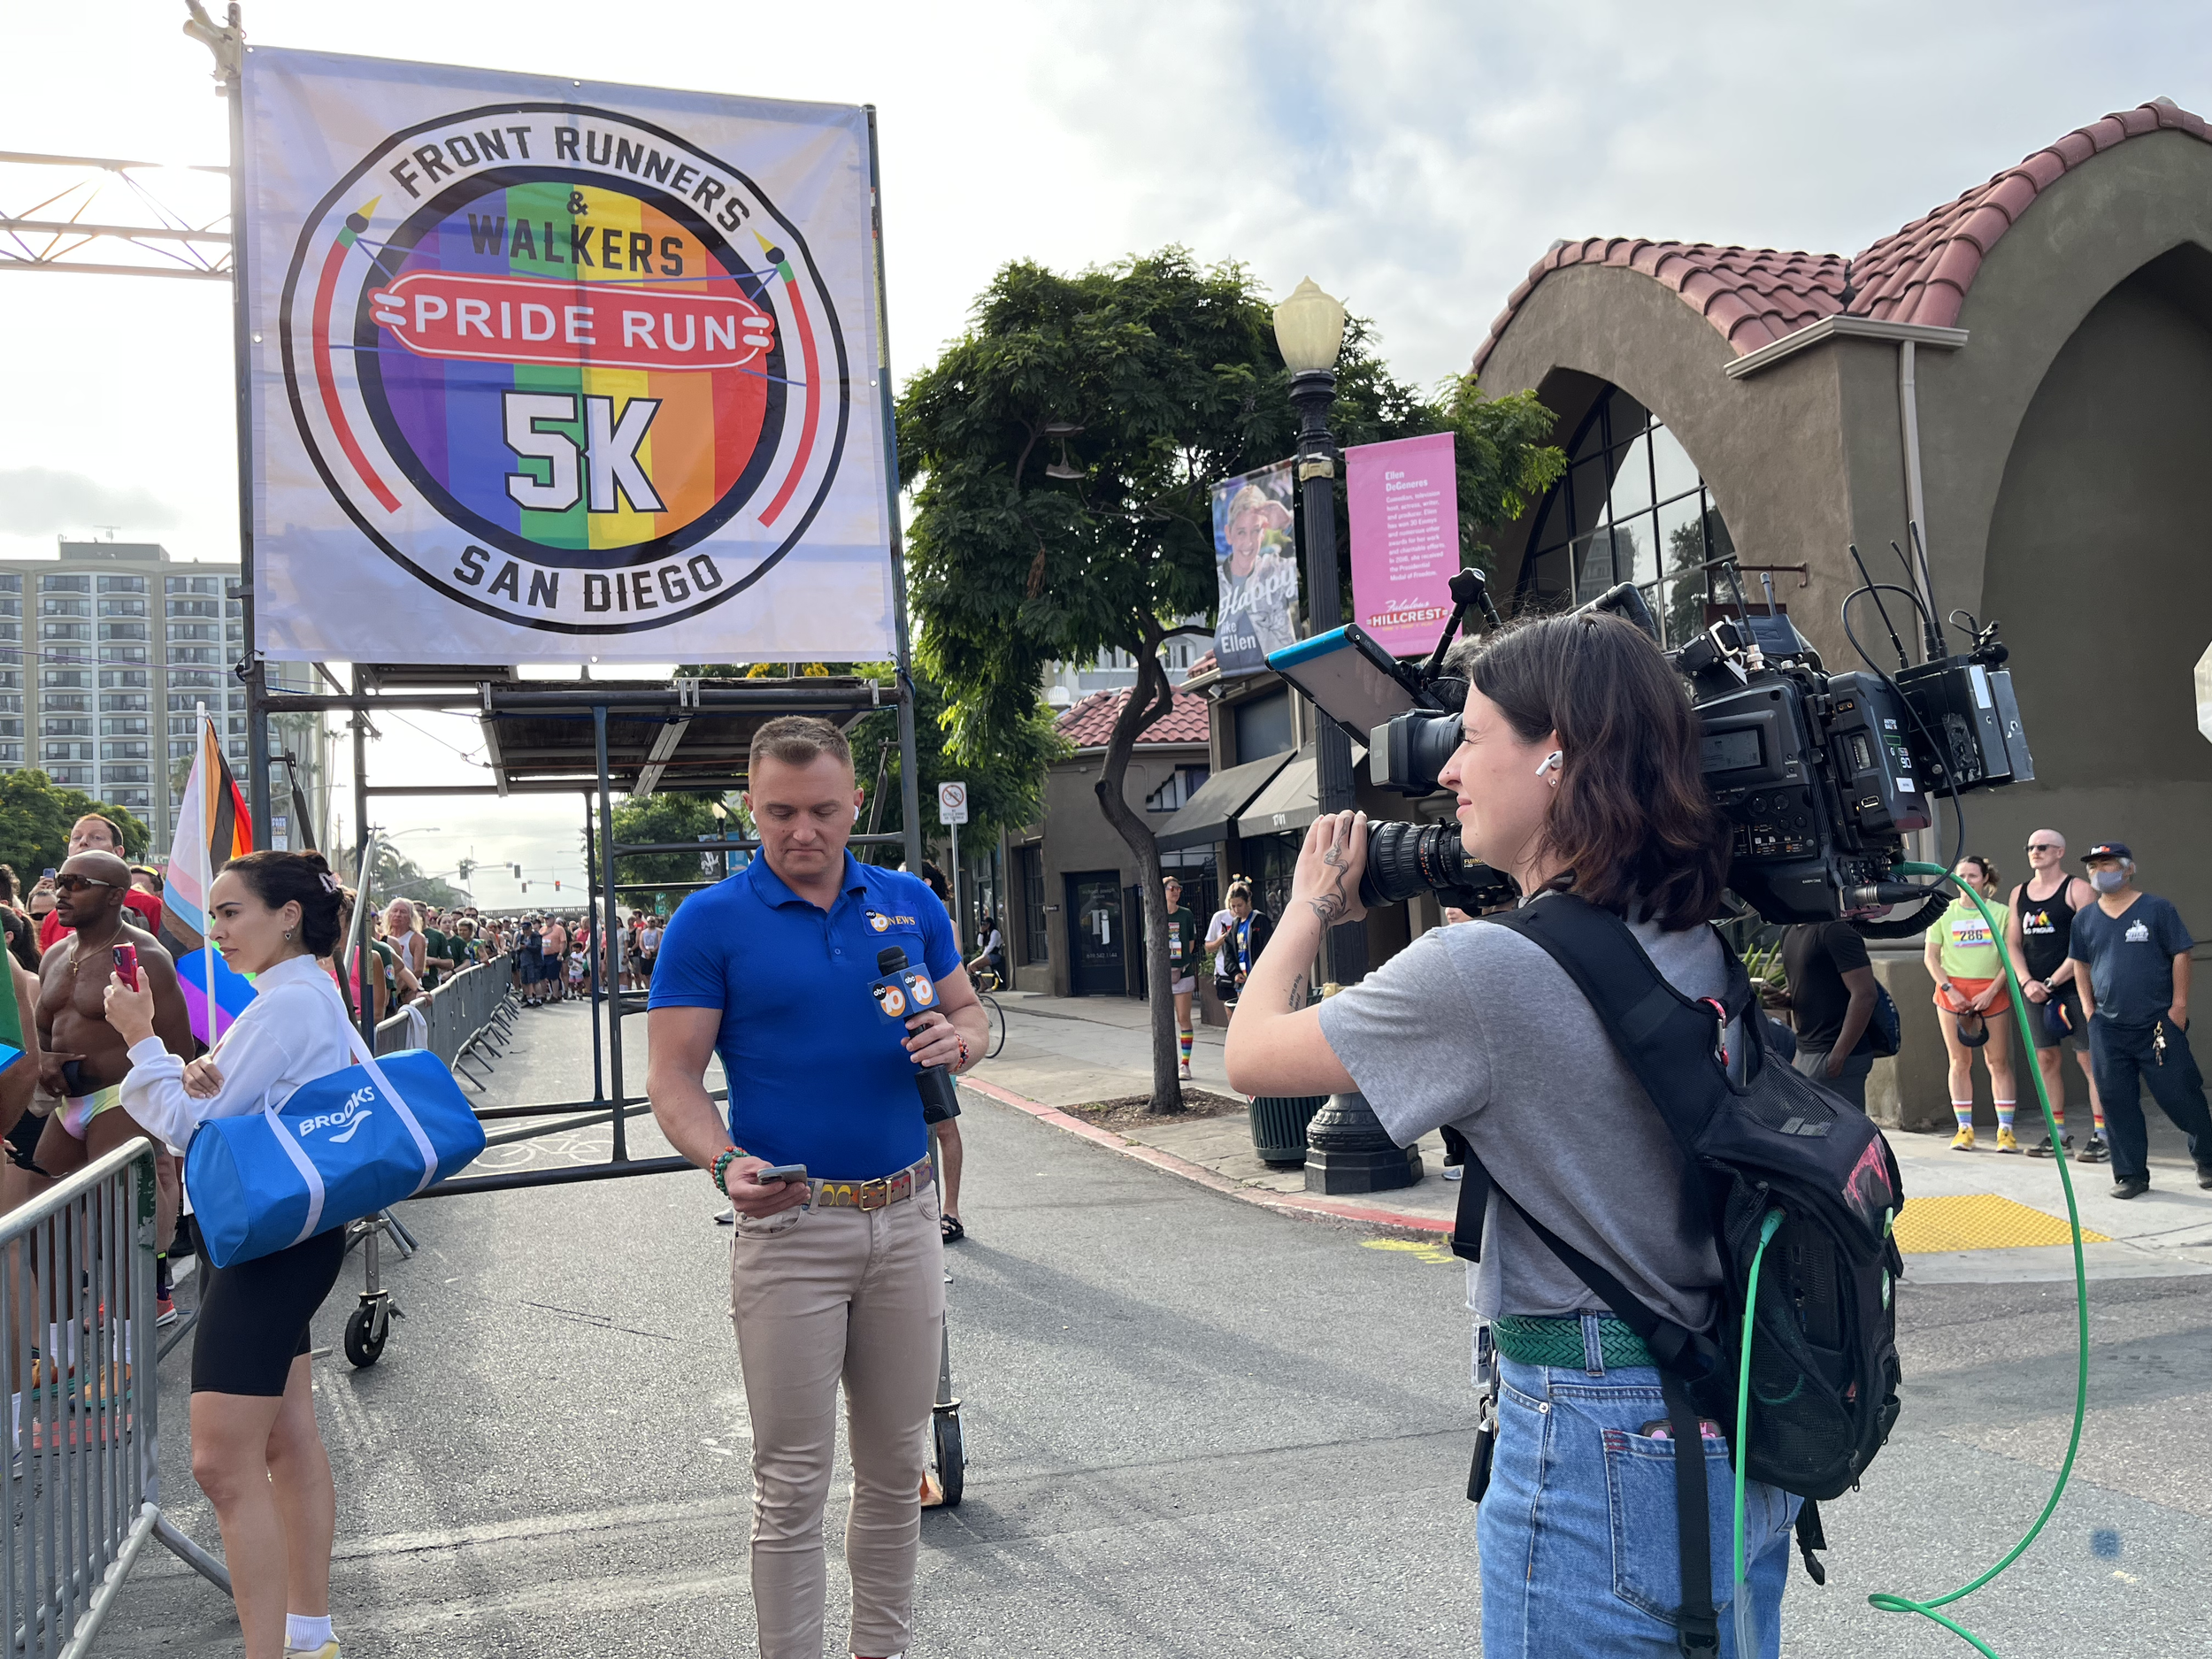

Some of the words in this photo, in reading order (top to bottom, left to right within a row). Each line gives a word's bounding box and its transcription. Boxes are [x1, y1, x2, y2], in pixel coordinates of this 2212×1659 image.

[389, 127, 532, 200] FRONT
[554, 127, 750, 232] RUNNERS
[566, 191, 588, 216] &
[467, 213, 684, 277] WALKERS
[414, 295, 596, 345] PRIDE
[622, 310, 736, 351] RUN
[501, 388, 669, 514] 5K
[1385, 471, 1405, 480] Ellen
[1386, 480, 1428, 492] DeGeneres
[452, 545, 560, 610] SAN
[583, 554, 723, 612] DIEGO
[1217, 566, 1299, 626] Happy
[1372, 608, 1442, 626] HILLCREST
[1221, 634, 1256, 654] Ellen
[887, 915, 916, 926] NEWS
[1960, 929, 1983, 941] 286
[873, 987, 886, 996] abc
[880, 989, 903, 1014] 10
[910, 979, 932, 1002] 10
[298, 1086, 375, 1137] BROOKS
